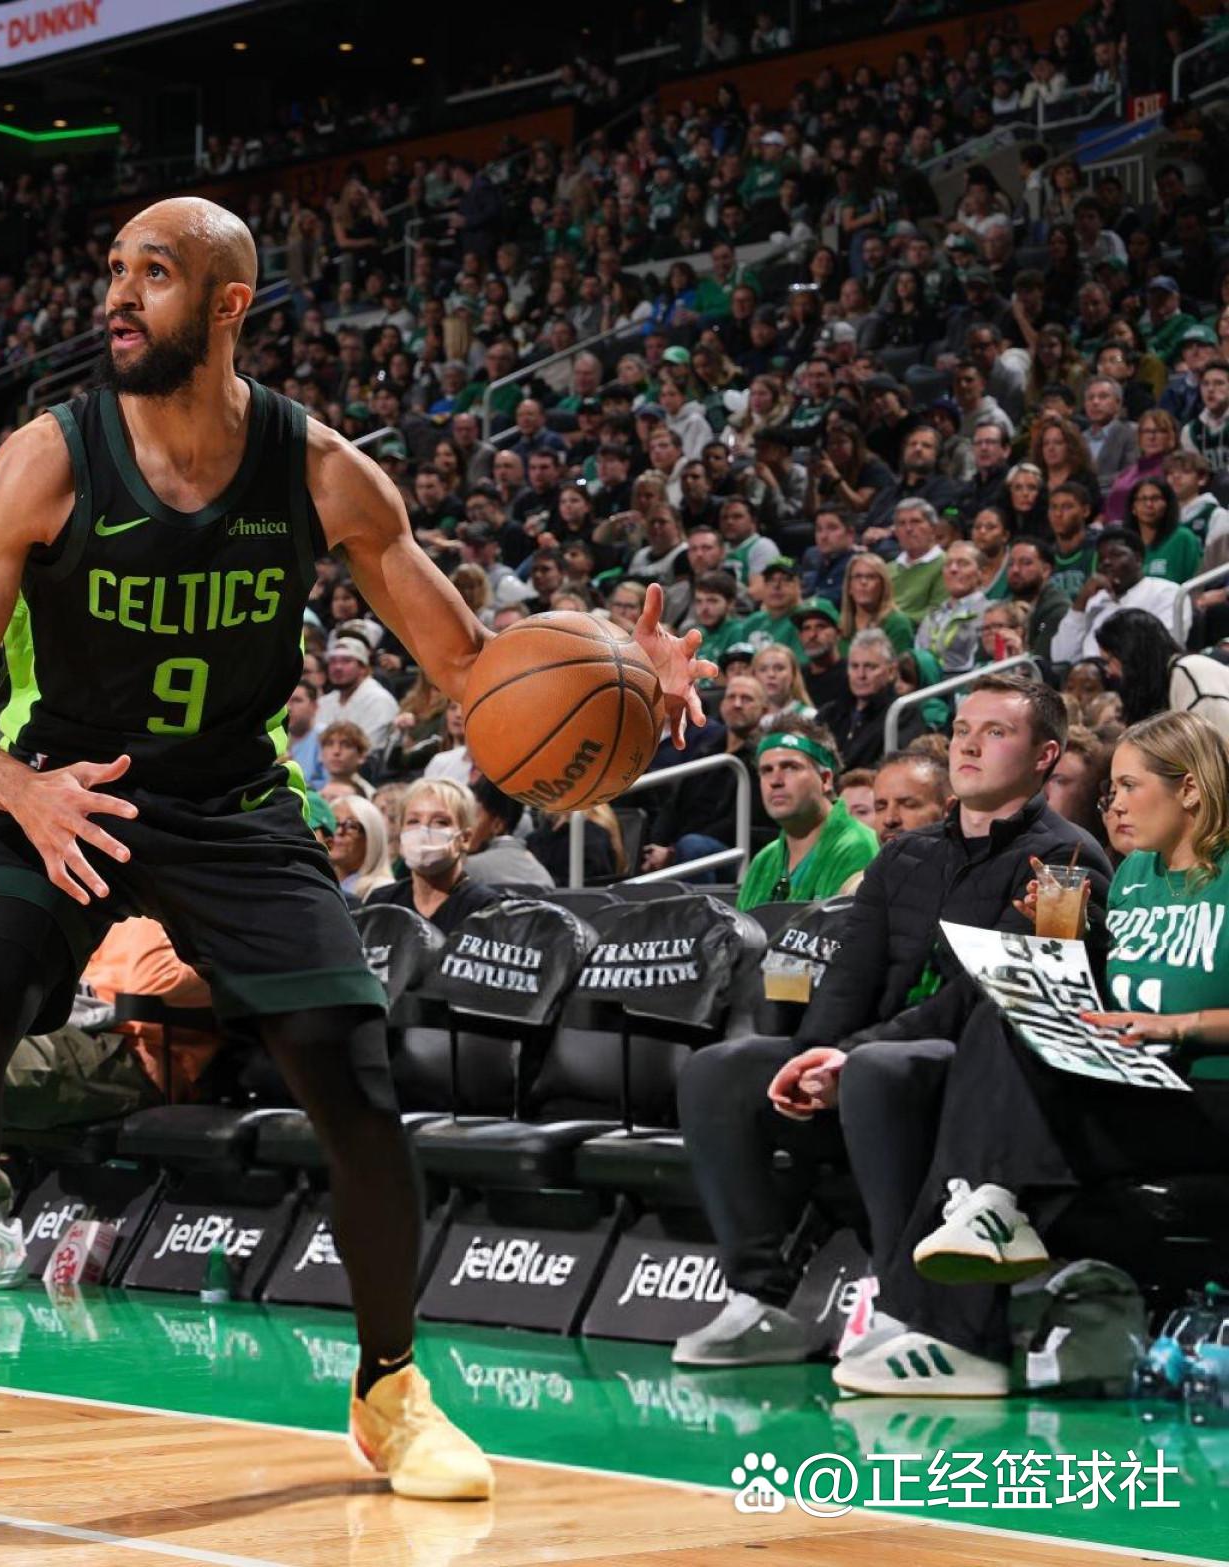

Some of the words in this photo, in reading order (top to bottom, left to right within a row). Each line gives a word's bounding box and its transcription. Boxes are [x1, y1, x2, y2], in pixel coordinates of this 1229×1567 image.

[8, 0, 102, 48] DUNKIN'
[228, 518, 288, 536] Amica
[88, 567, 285, 634] CELTICS
[147, 657, 209, 734] 9
[154, 1213, 264, 1259] jetBlue
[451, 1237, 576, 1286] jetBlue
[618, 1254, 730, 1304] jetBlu
